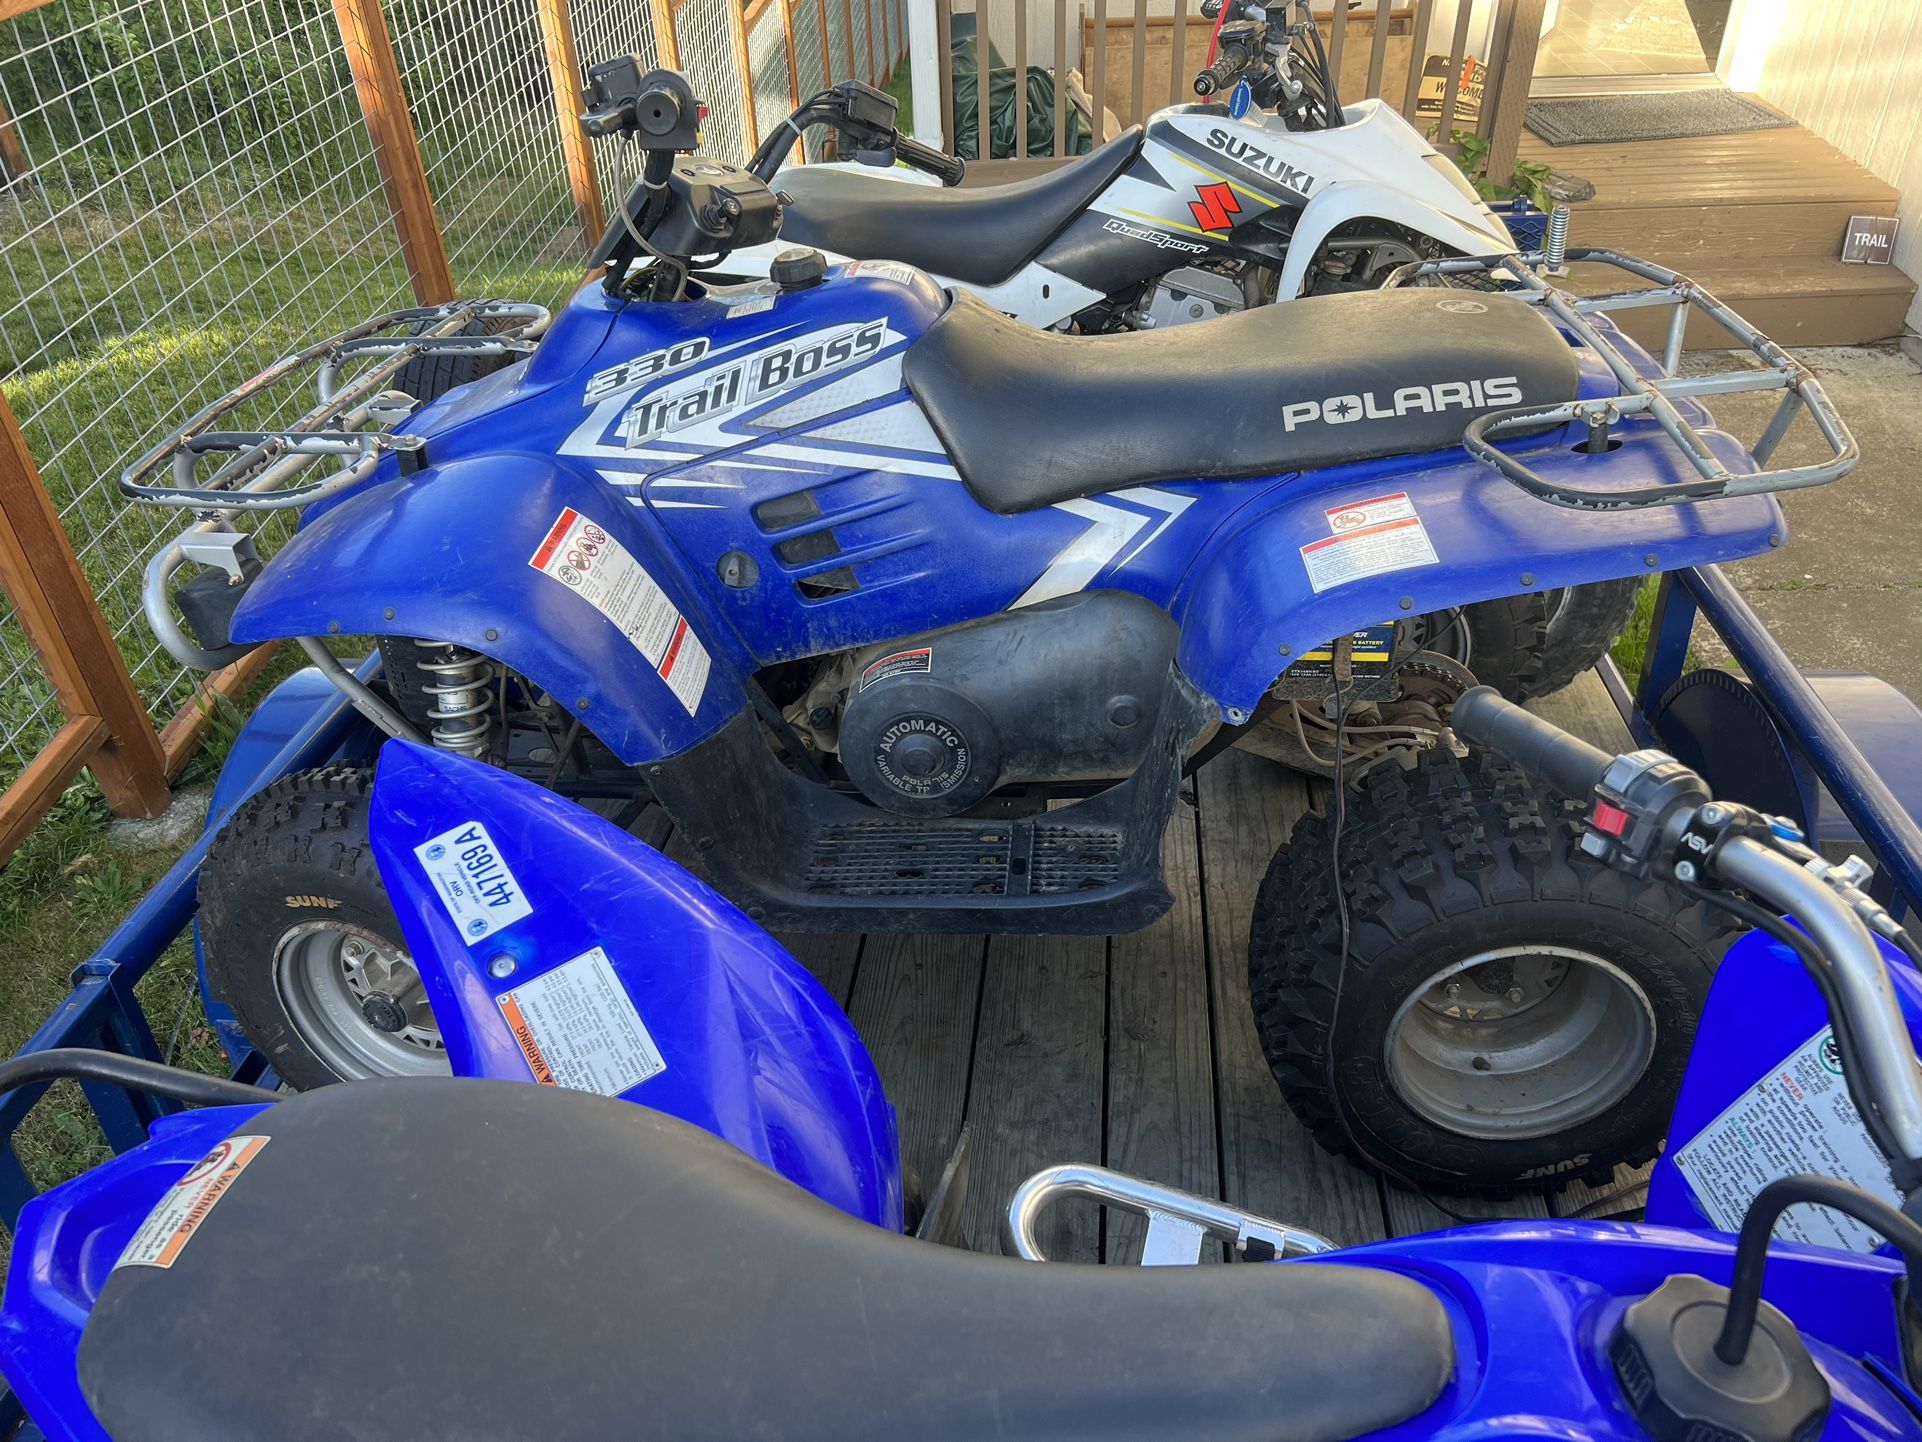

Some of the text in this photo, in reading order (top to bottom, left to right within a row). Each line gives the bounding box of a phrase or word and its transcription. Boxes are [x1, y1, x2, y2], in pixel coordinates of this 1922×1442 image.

[1206, 128, 1315, 195] SUZUKI
[1102, 218, 1209, 254] QuadSport
[1854, 232, 1888, 248] TRAIL
[588, 338, 709, 401] 330
[627, 318, 888, 443] Trail Boss
[1282, 376, 1523, 432] POLARIS
[880, 719, 958, 752] AUTOMATIC
[877, 754, 912, 792] VARIABLE
[451, 826, 521, 911] 447169 A
[452, 861, 481, 904] OFF-ROAD VEHICLE
[448, 879, 464, 897] ORV
[515, 1025, 547, 1074] WARNING
[626, 1056, 642, 1079] LOADING
[560, 1059, 576, 1083] CONTROL
[1779, 1070, 1804, 1102] NEVER
[1727, 1115, 1754, 1150] ALWAYS
[178, 1174, 231, 1233] WARNING
